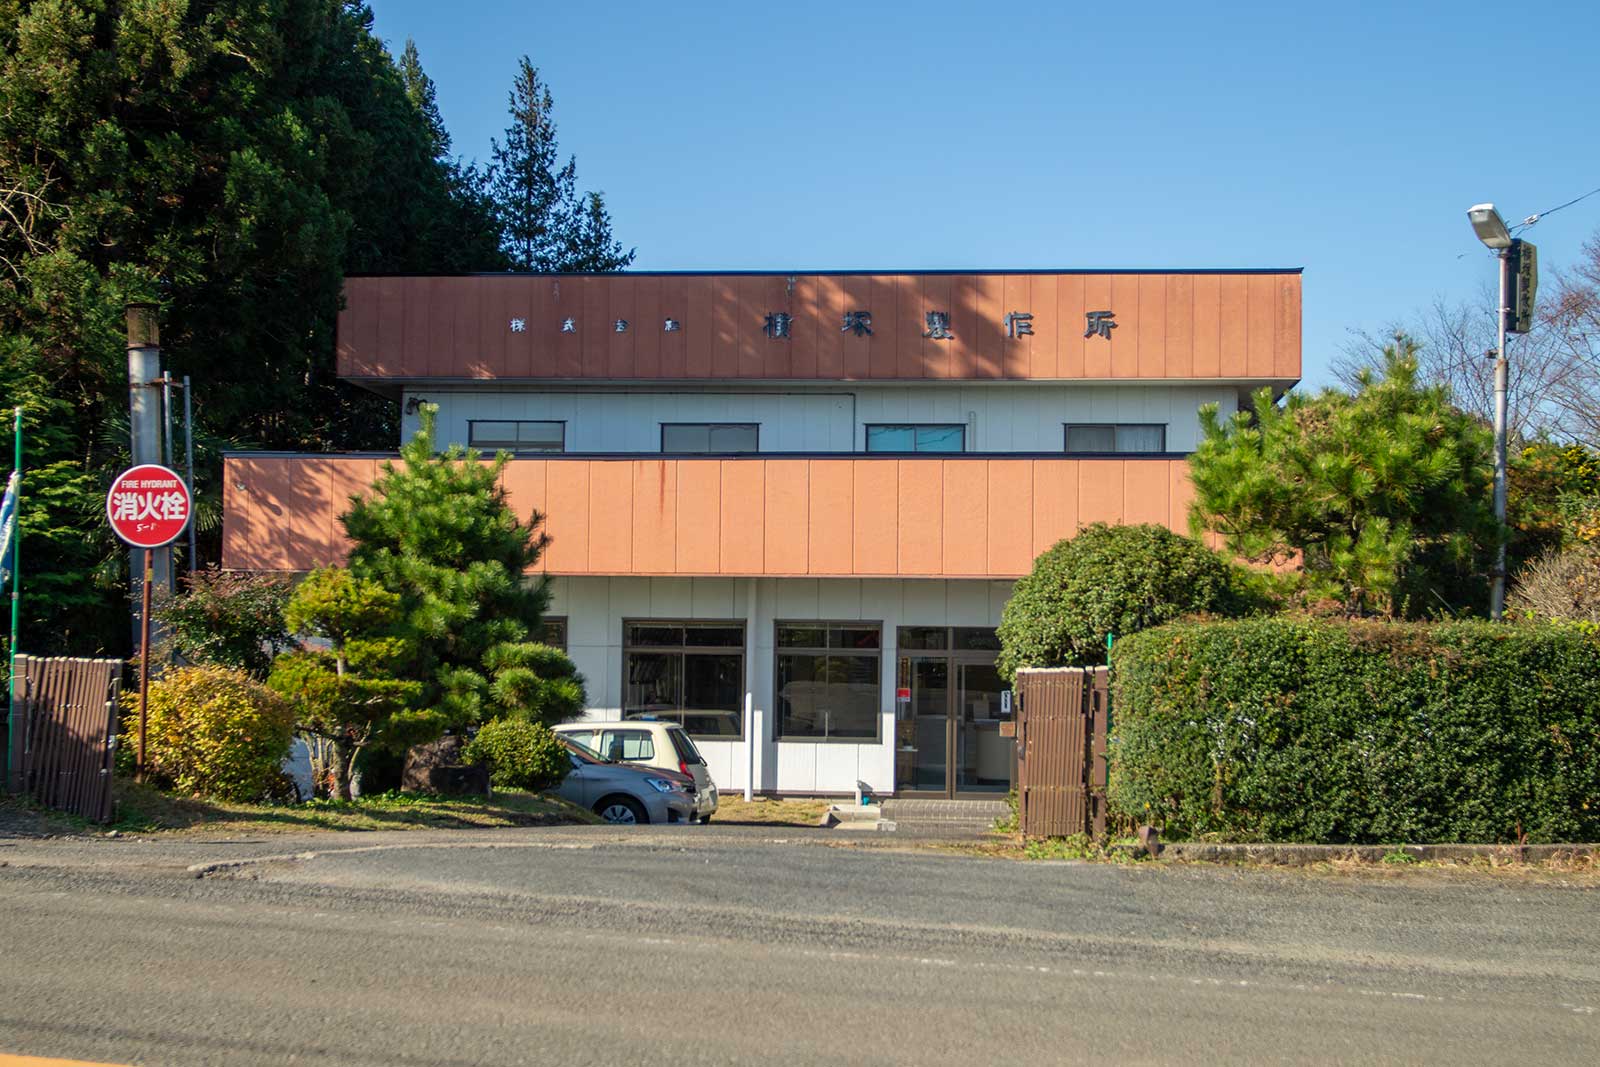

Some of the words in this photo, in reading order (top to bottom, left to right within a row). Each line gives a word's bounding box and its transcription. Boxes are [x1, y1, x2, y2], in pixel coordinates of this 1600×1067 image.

[510, 317, 680, 333] 株式会社
[121, 480, 139, 488] FIRE
[140, 480, 177, 488] HYDRANT
[113, 491, 186, 520] 消火栓
